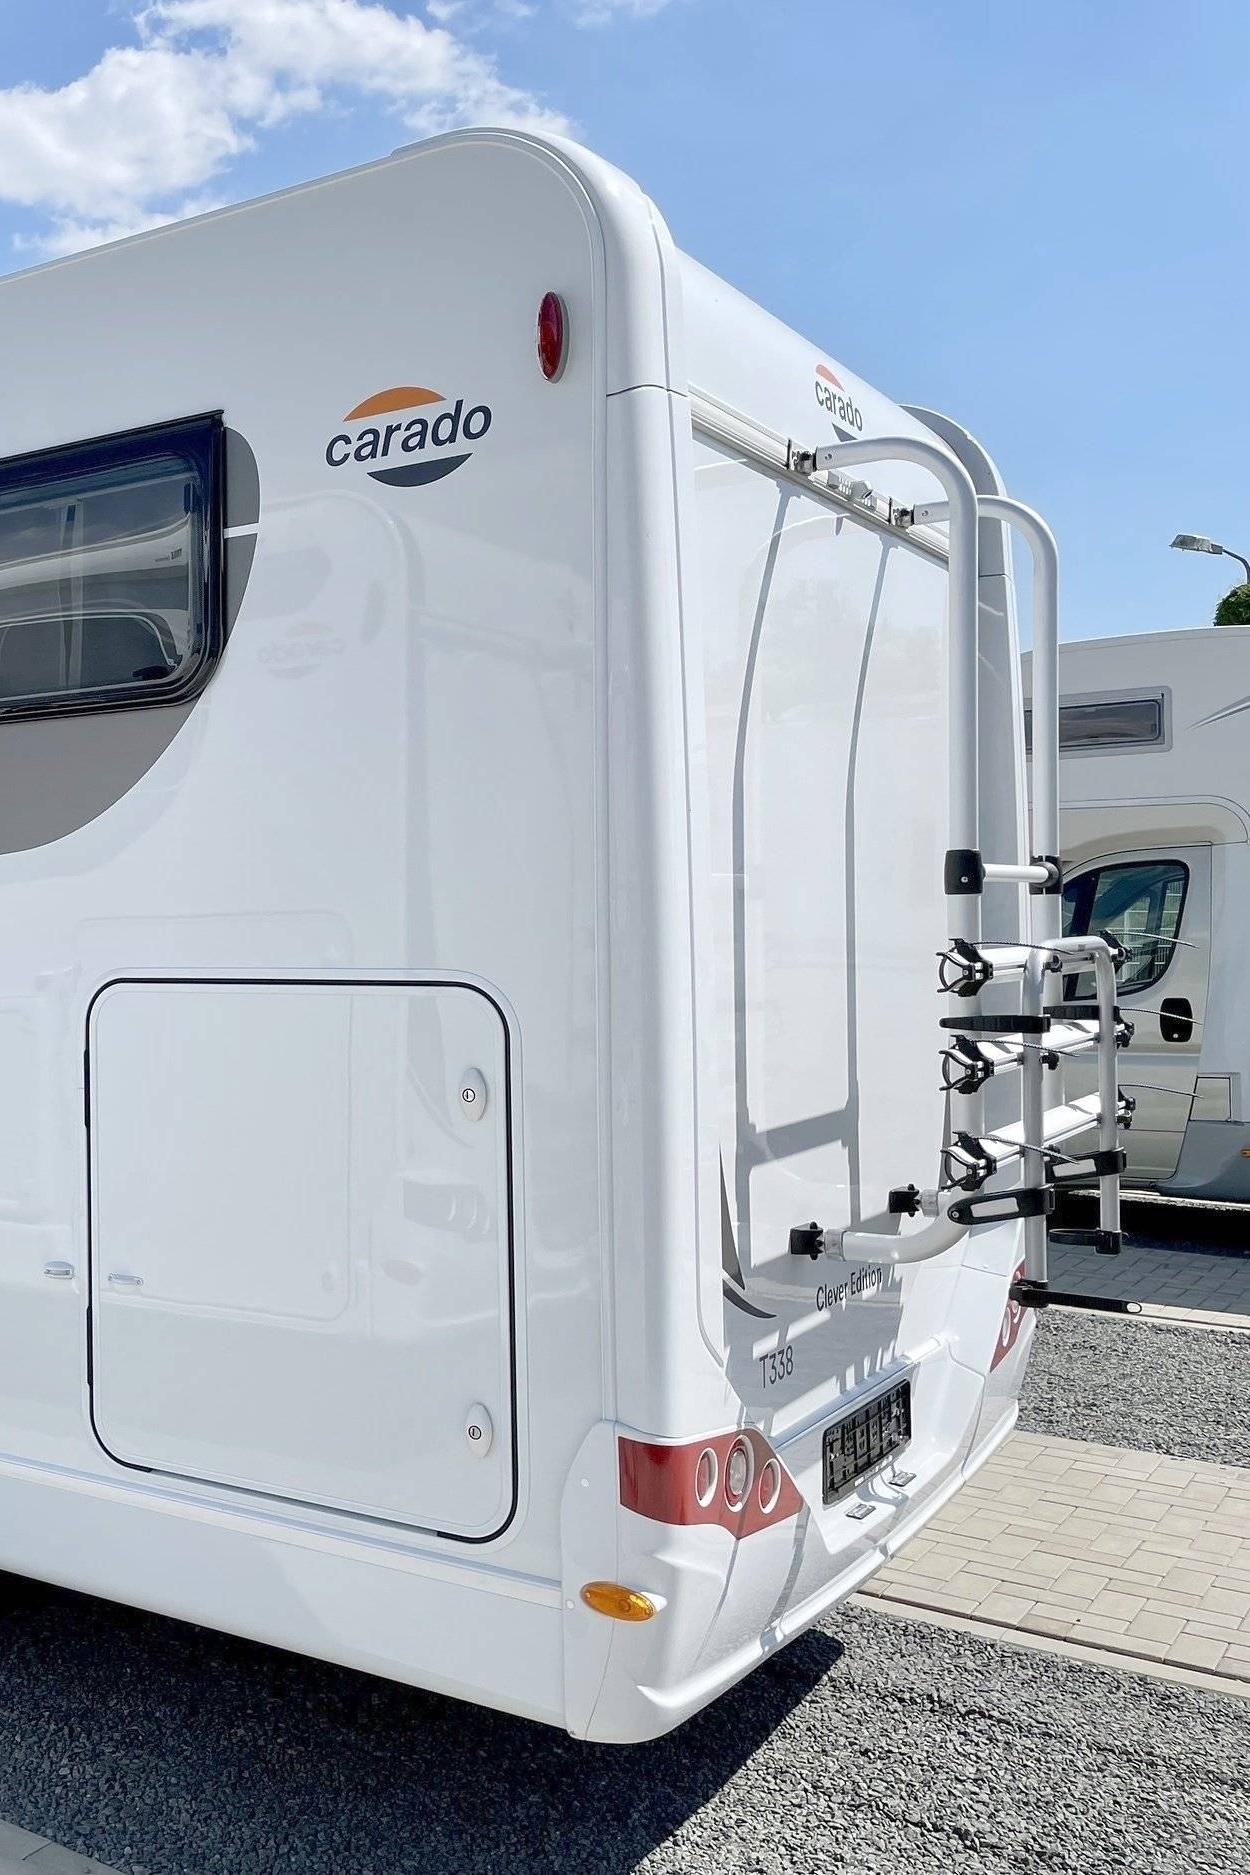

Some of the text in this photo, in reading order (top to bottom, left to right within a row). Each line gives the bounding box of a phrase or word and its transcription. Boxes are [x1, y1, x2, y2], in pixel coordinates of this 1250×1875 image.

[814, 380, 862, 432] carado
[325, 399, 492, 467] carado
[816, 1265, 882, 1312] Clever Edition
[758, 1345, 793, 1388] T338
